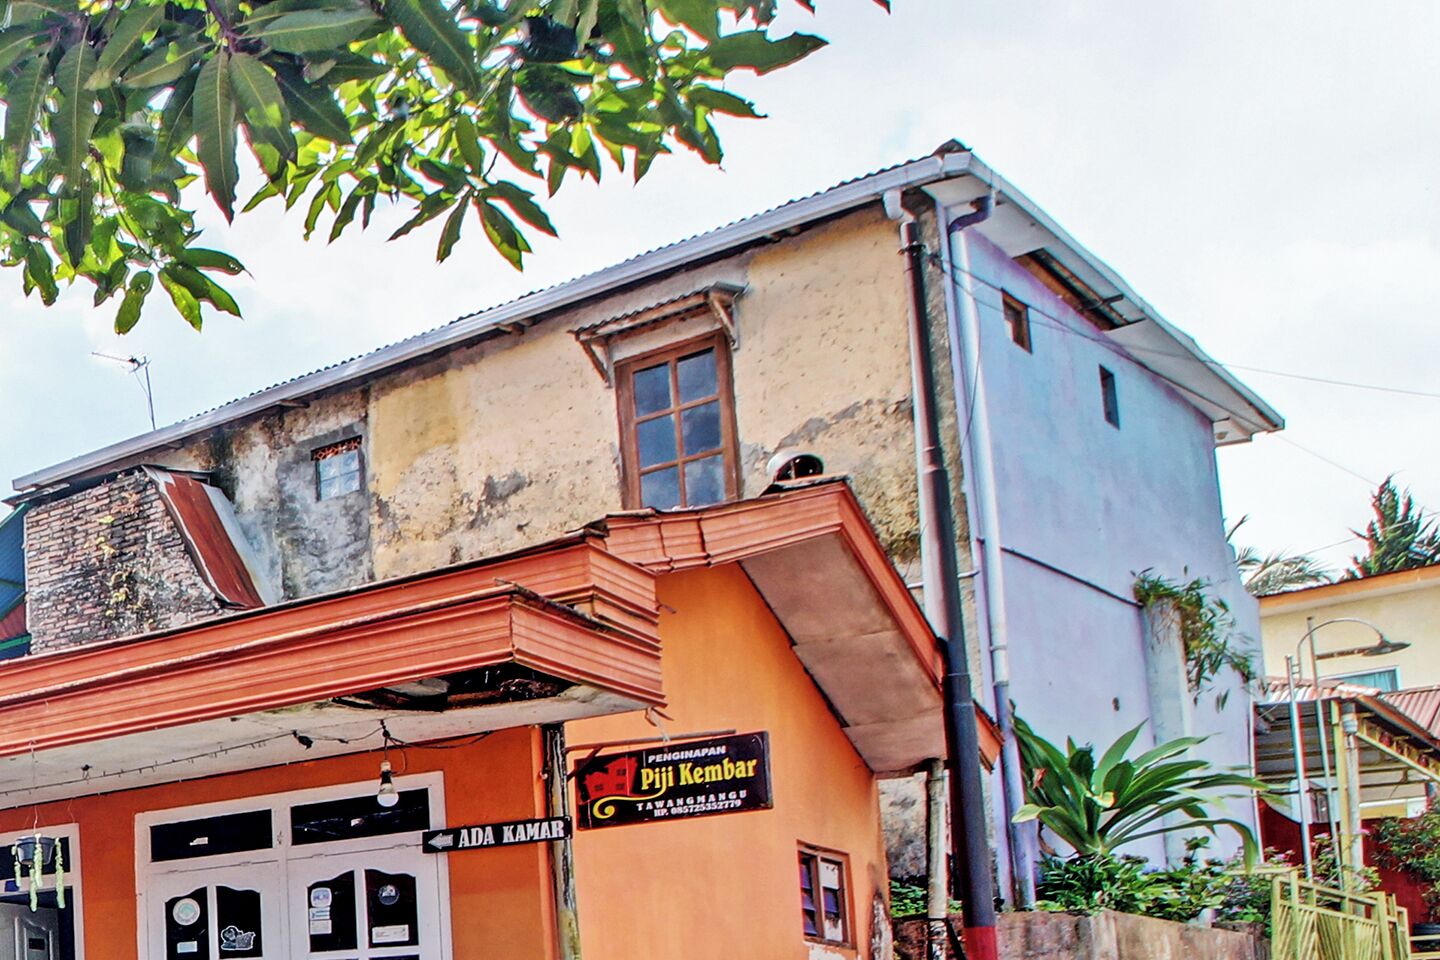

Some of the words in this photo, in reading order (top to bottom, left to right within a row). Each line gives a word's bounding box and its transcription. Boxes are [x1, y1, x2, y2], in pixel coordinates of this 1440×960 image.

[648, 745, 726, 763] PENGINAPAN
[641, 766, 675, 796] Piji
[679, 757, 757, 786] Kembar
[636, 790, 747, 811] TAWANGMANGU
[458, 826, 495, 848] ADA
[502, 820, 565, 844] KAMAR
